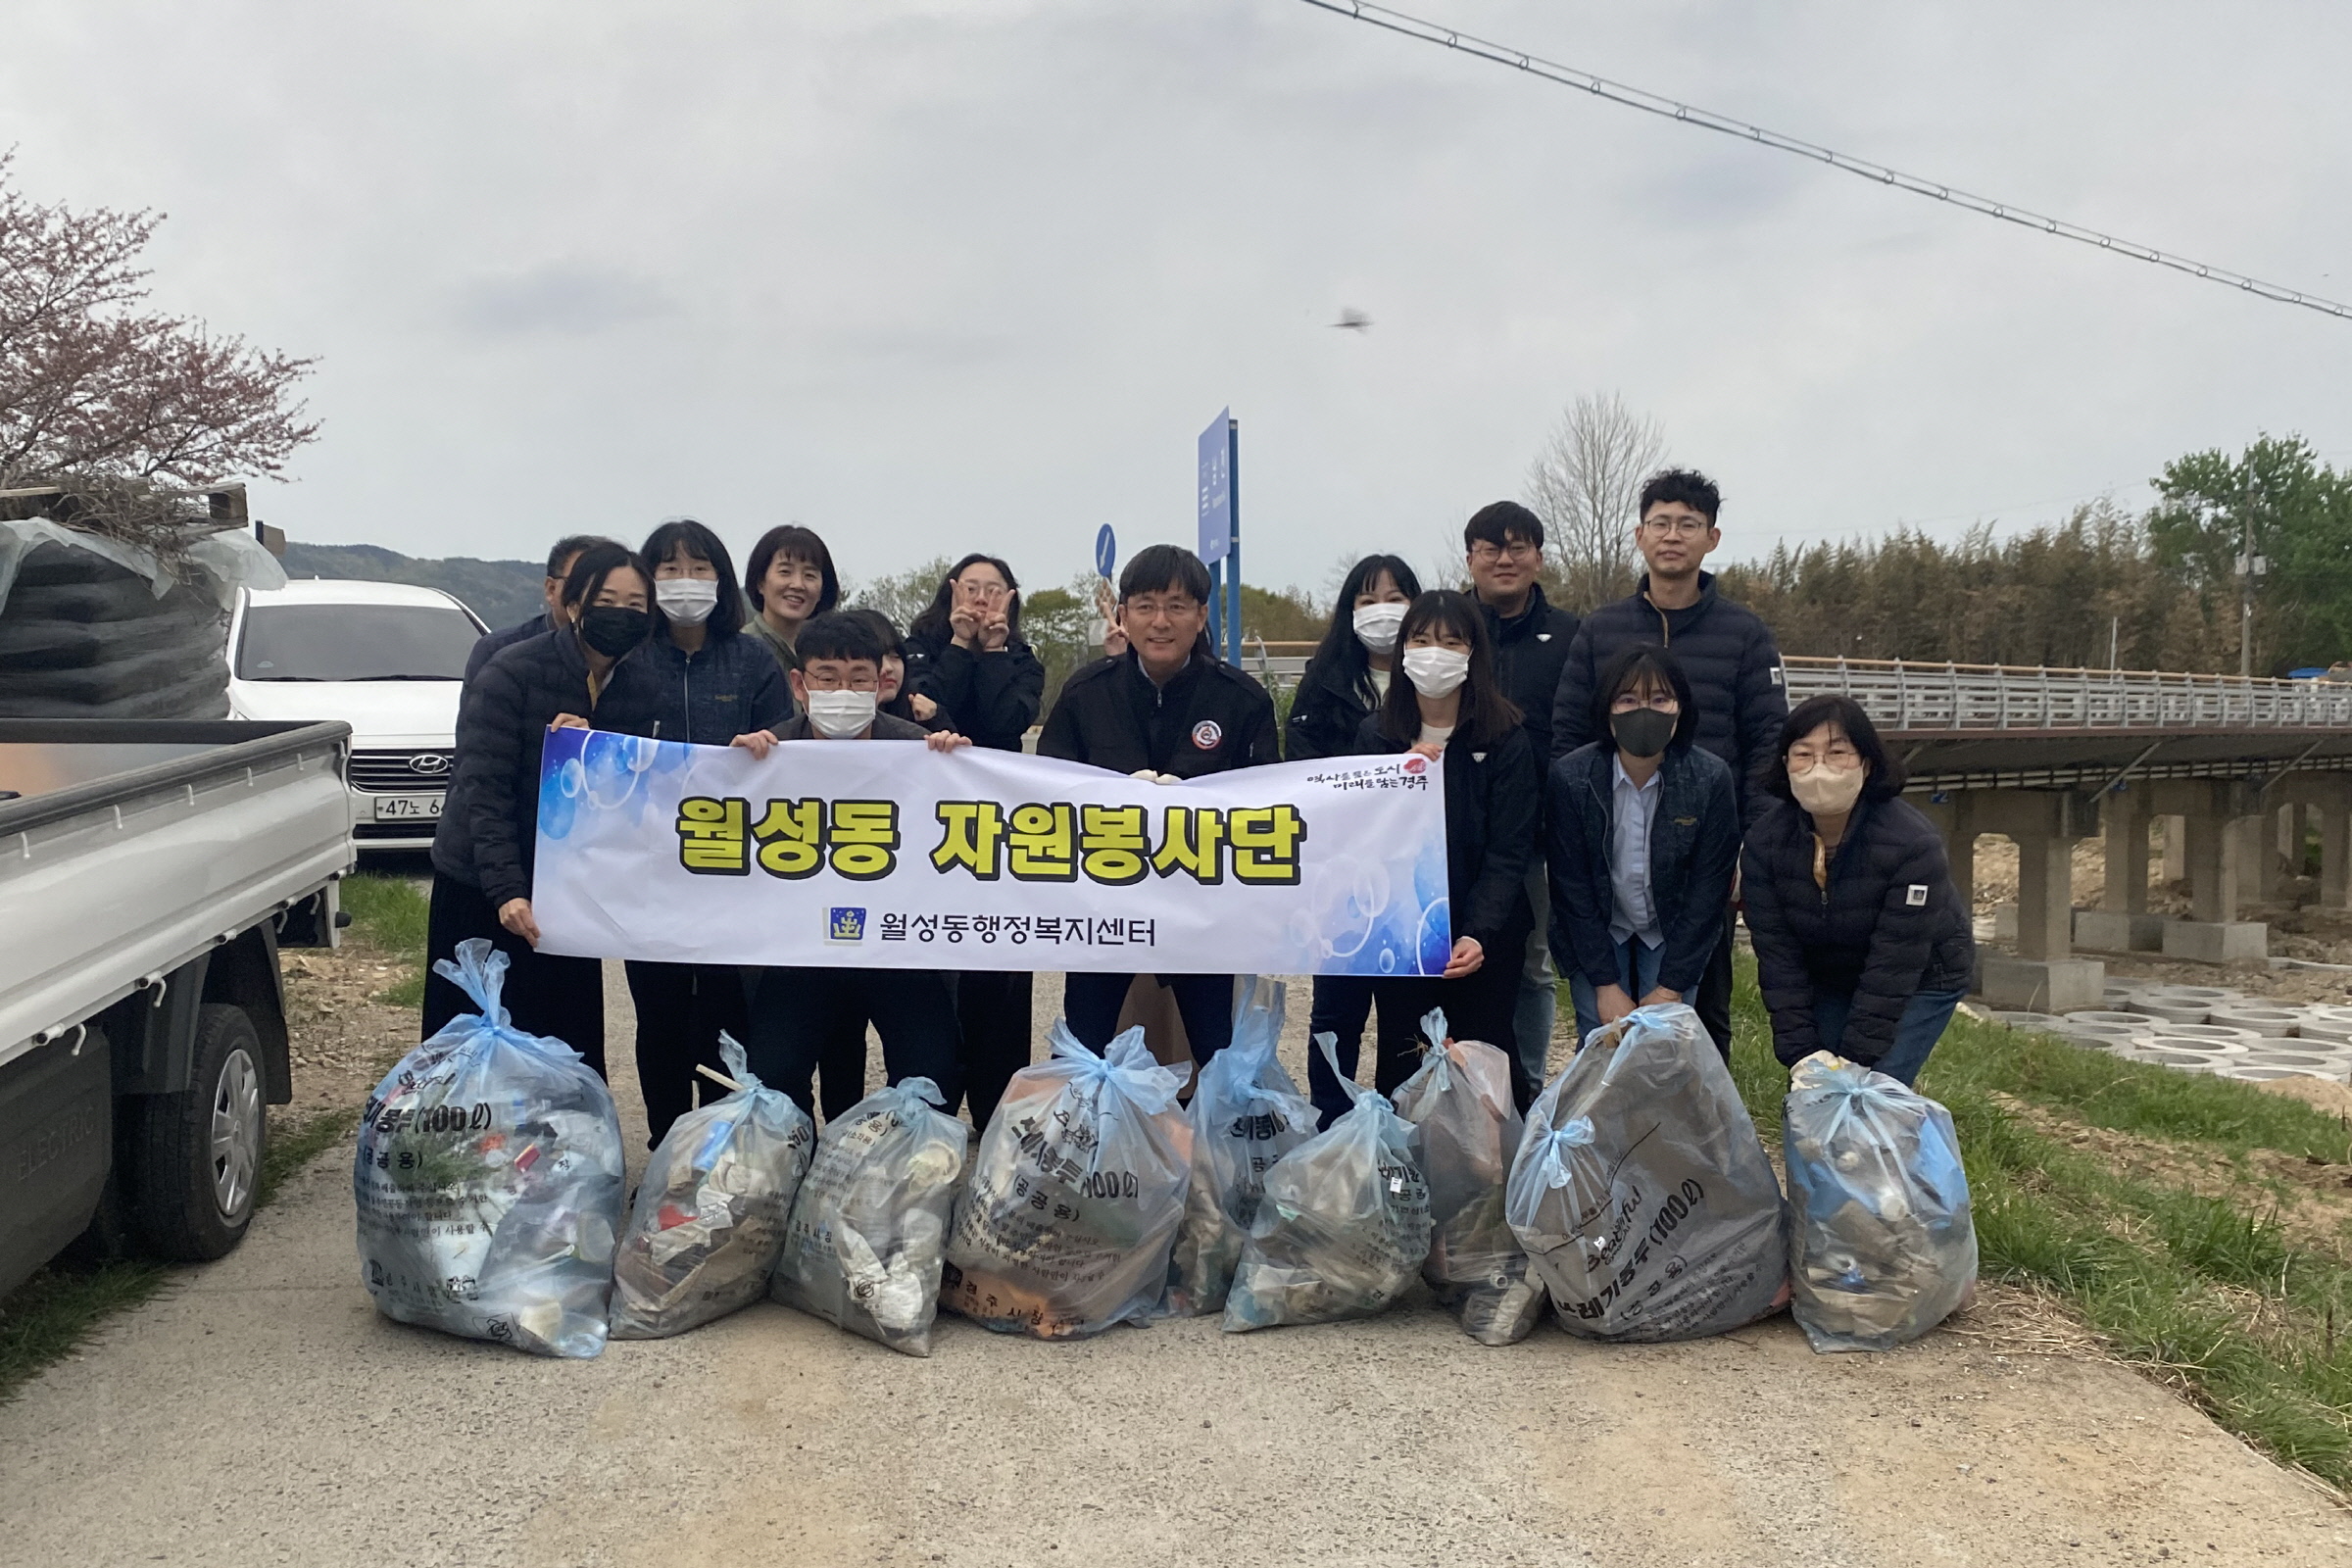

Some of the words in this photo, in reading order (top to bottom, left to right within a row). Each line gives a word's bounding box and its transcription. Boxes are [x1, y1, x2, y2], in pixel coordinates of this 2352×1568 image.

[1374, 763, 1400, 775] 도시
[1333, 777, 1375, 790] 미래를
[1376, 776, 1398, 788] 담는
[1398, 774, 1429, 791] 경주
[386, 800, 420, 815] 47노
[675, 796, 901, 881] 월성동
[928, 800, 1306, 886] 자원봉사단
[879, 912, 1155, 948] 월성동행정복지센터
